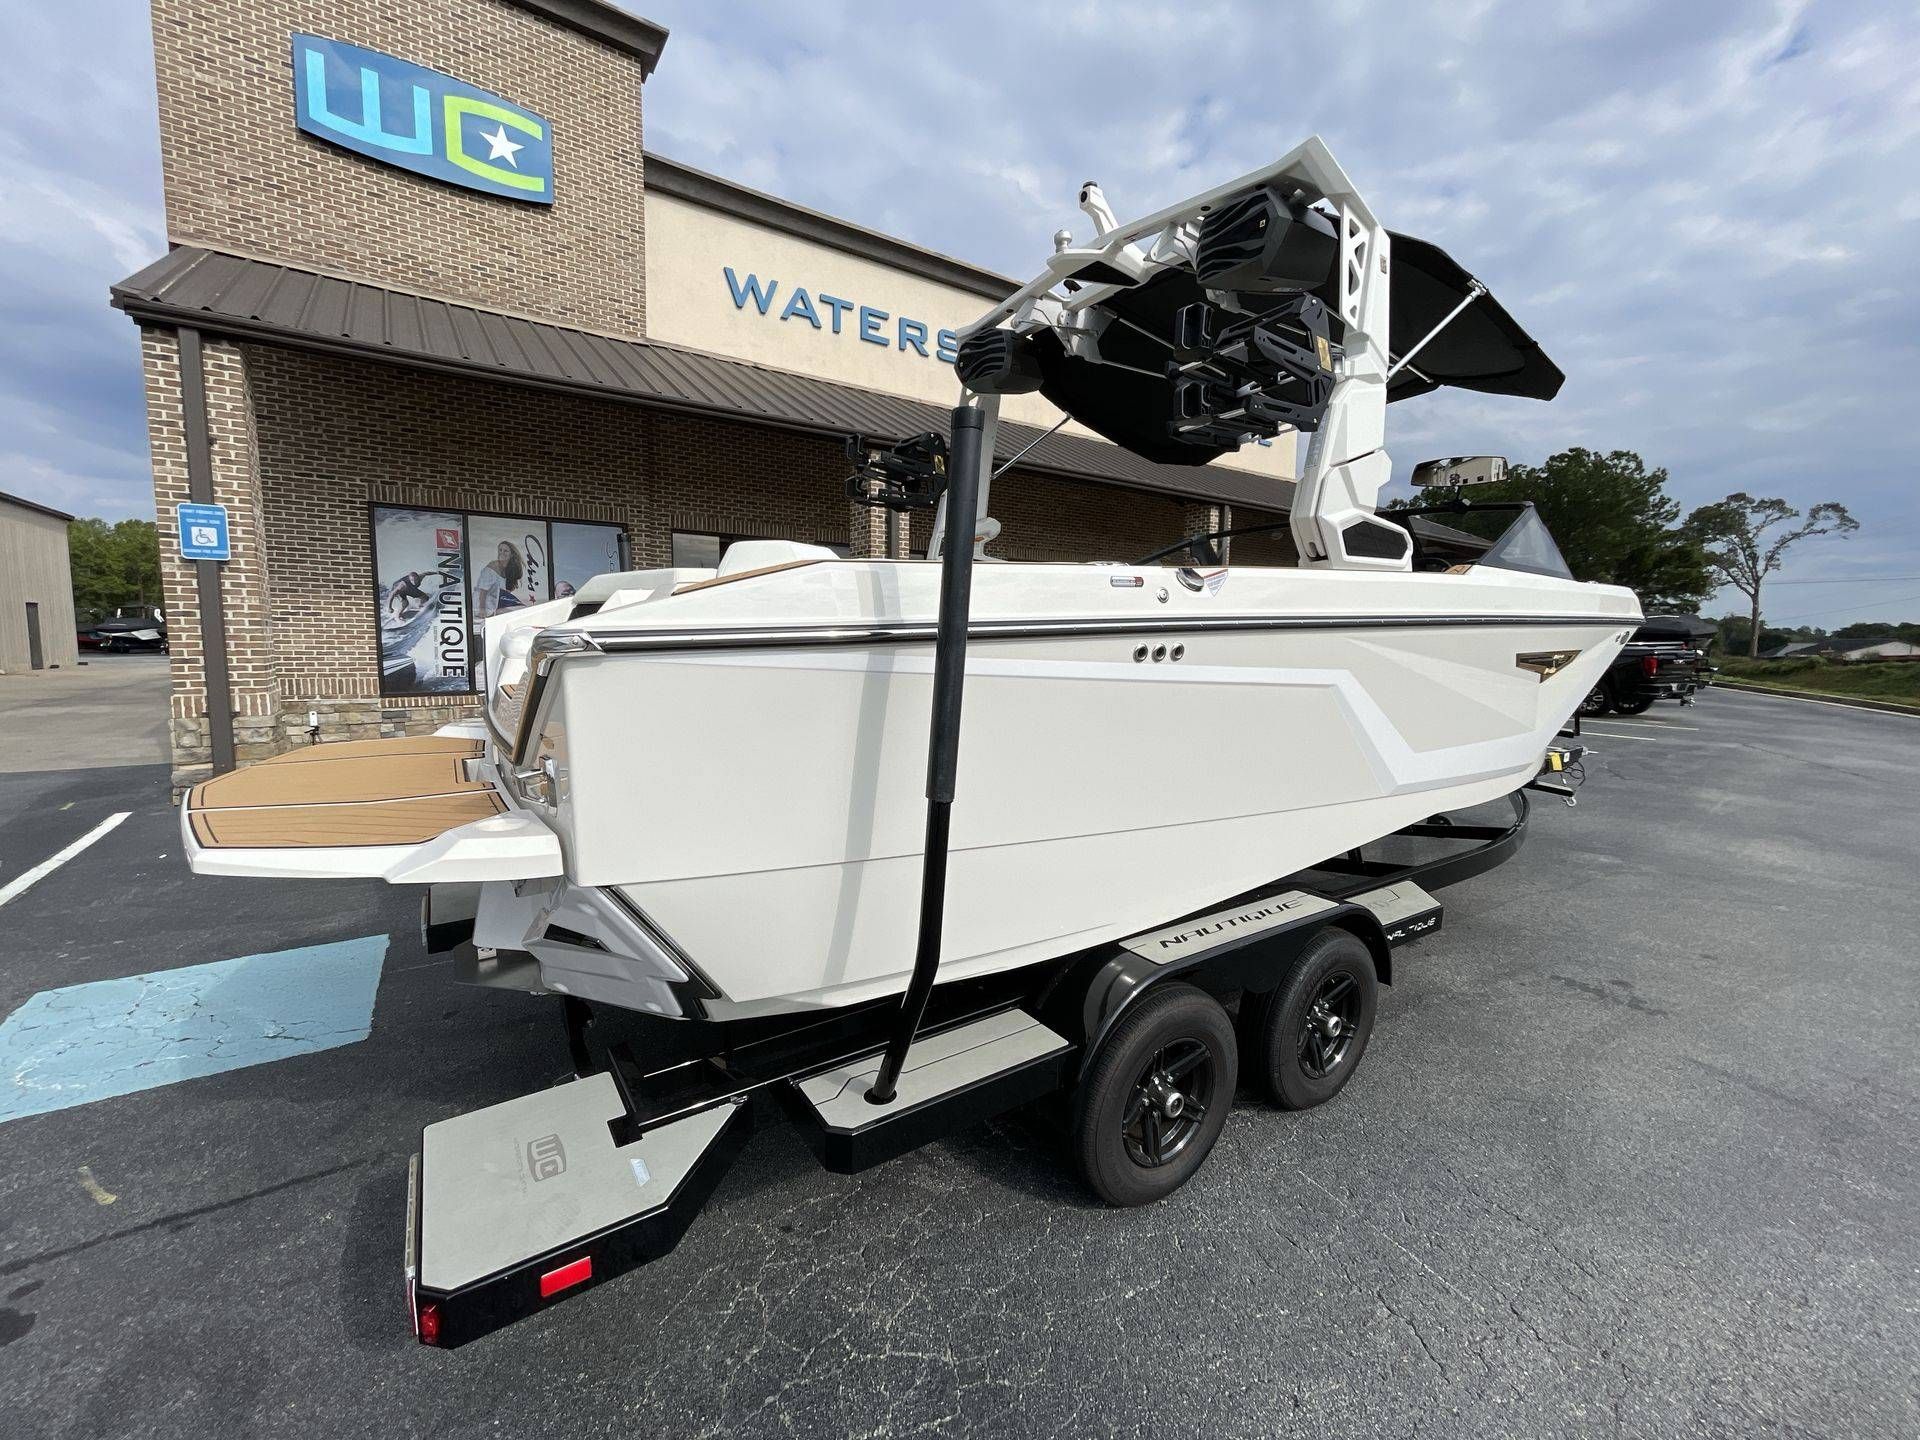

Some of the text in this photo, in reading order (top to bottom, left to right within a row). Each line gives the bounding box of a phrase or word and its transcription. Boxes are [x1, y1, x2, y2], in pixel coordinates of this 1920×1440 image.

[305, 48, 545, 193] WC
[723, 266, 958, 364] WATERS
[524, 534, 545, 592] Chris
[437, 551, 465, 677] NAUTIQUE
[1159, 899, 1304, 949] NAUTIQUE
